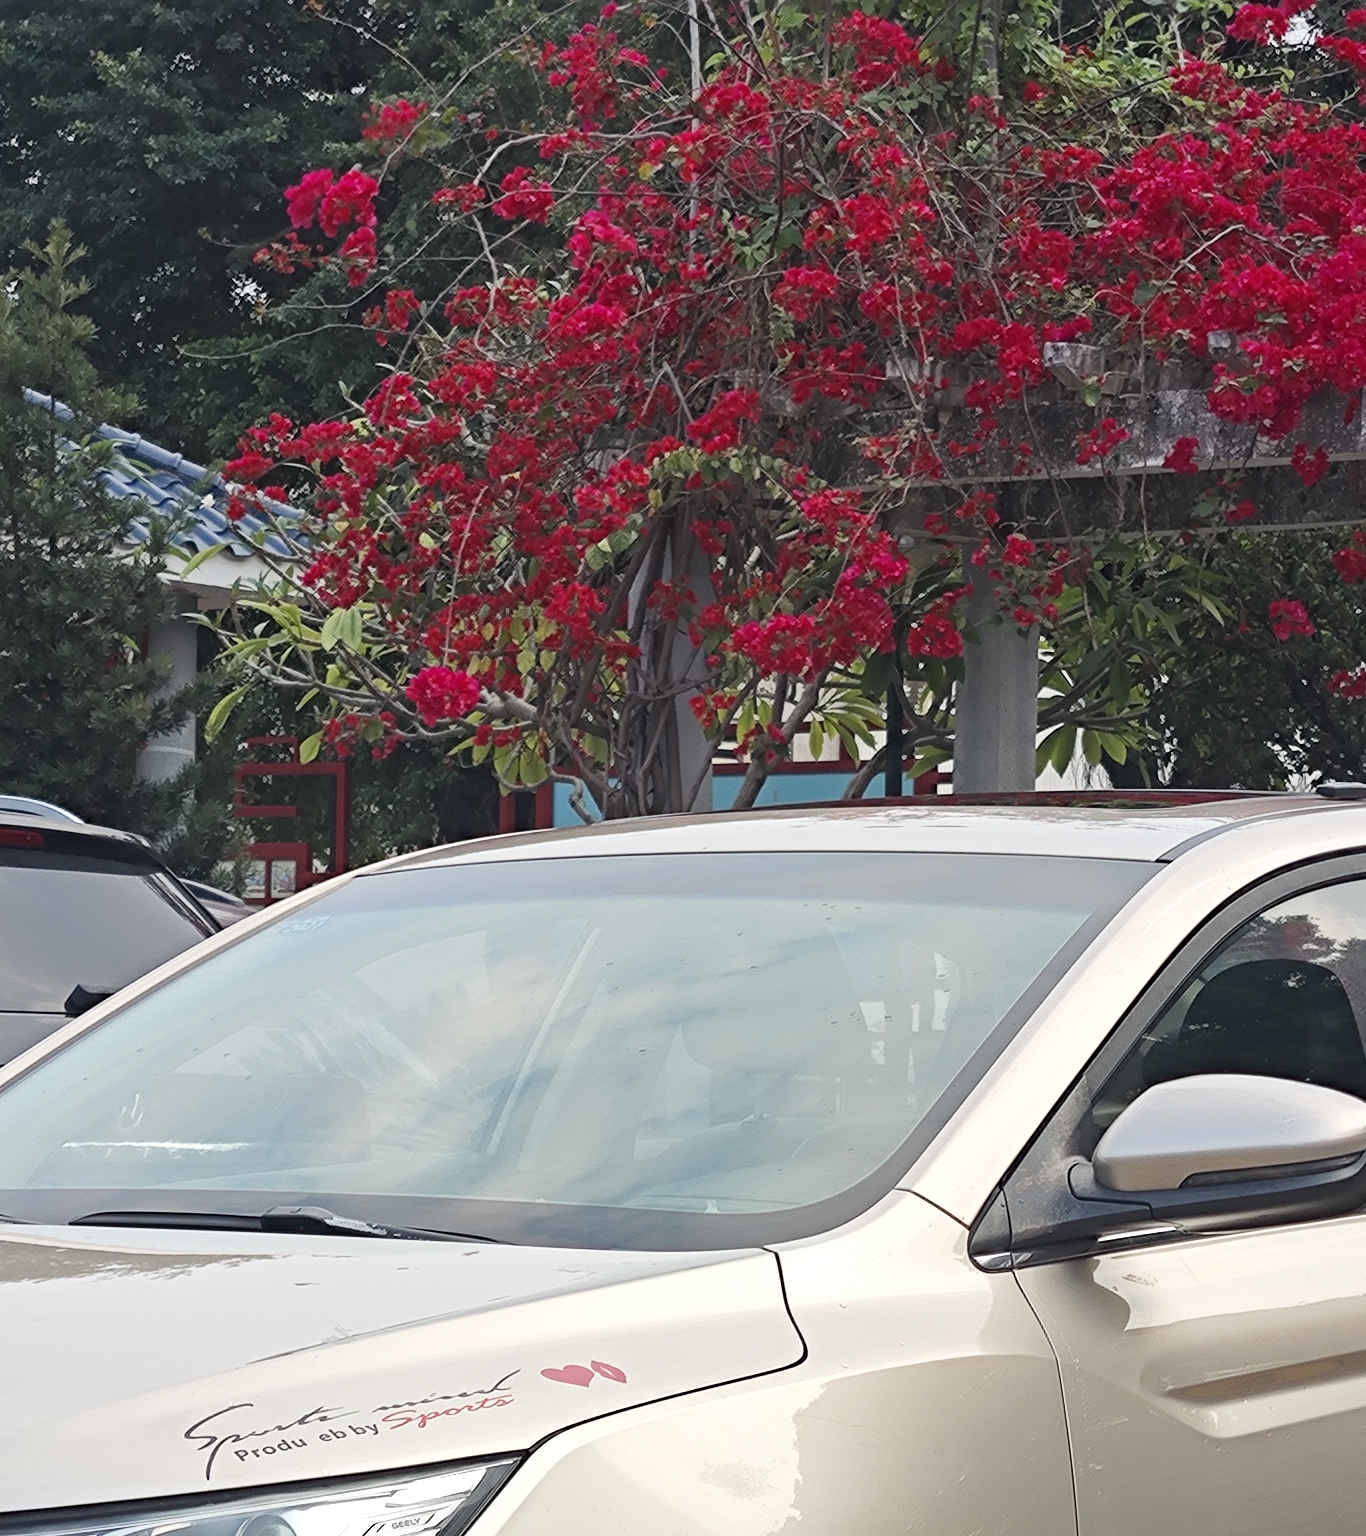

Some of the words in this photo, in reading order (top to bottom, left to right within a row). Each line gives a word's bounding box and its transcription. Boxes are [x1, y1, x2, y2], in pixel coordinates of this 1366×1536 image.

[349, 1421, 380, 1436] by
[381, 1394, 516, 1430] Sports
[391, 1517, 422, 1531] GEELY
